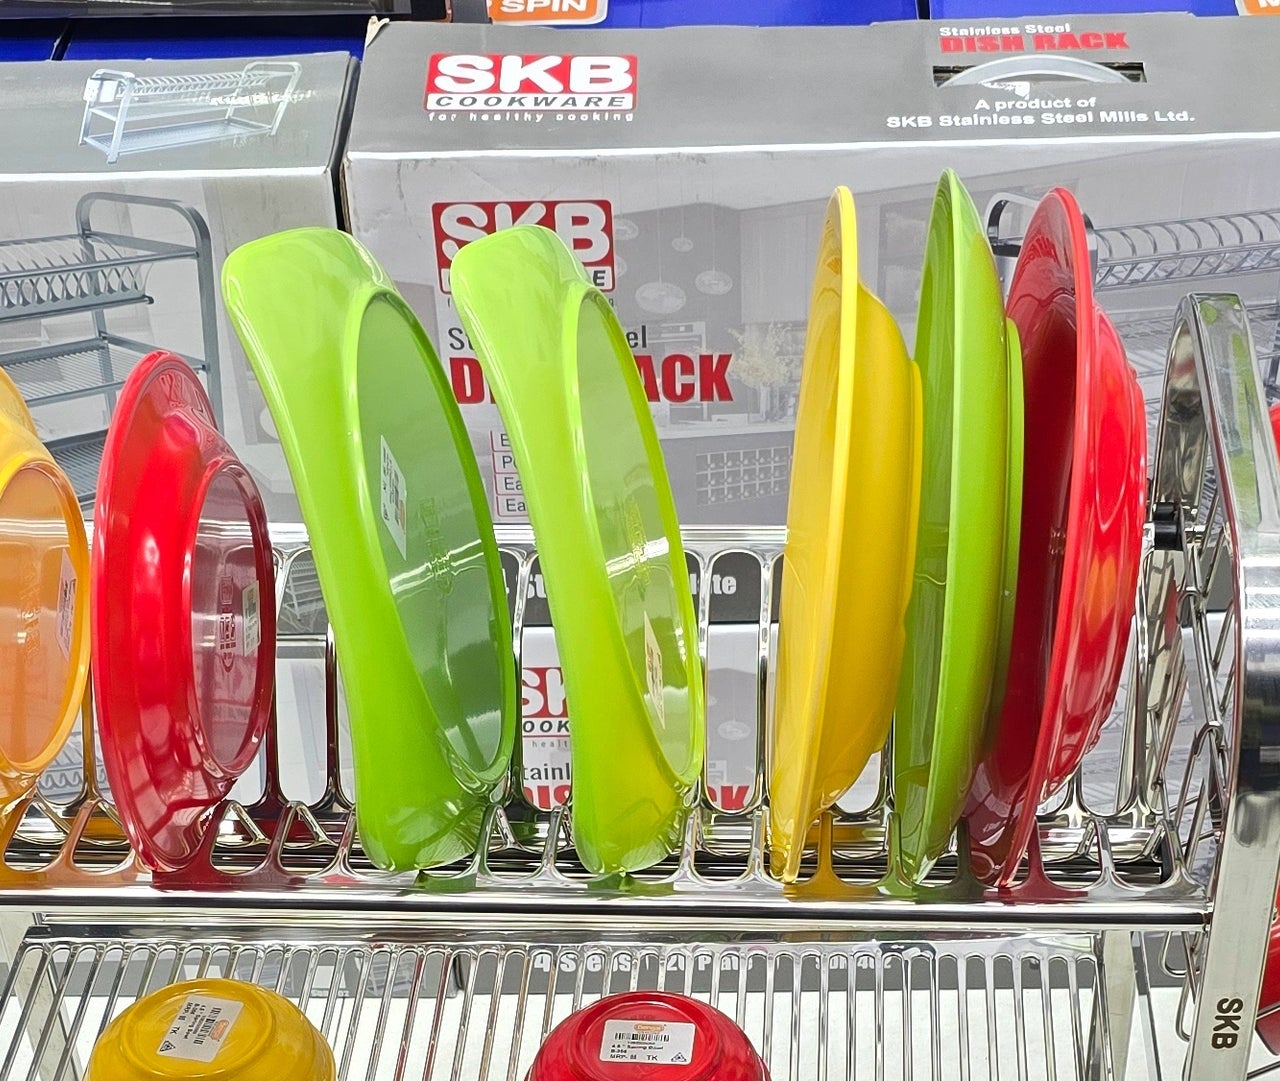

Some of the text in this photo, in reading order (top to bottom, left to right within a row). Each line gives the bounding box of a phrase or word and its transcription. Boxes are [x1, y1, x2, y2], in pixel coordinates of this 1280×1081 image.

[939, 23, 1070, 36] Stainless Steel
[940, 32, 1129, 53] DISH RACK
[434, 55, 633, 93] SKB
[435, 96, 625, 107] COOKWARE
[975, 97, 1096, 112] A product of
[428, 112, 633, 122] for healthy cooking
[886, 110, 1195, 128] SKB Stainless Steel Mills Ltd.
[634, 353, 734, 402] ACK
[1211, 998, 1244, 1049] SKB
